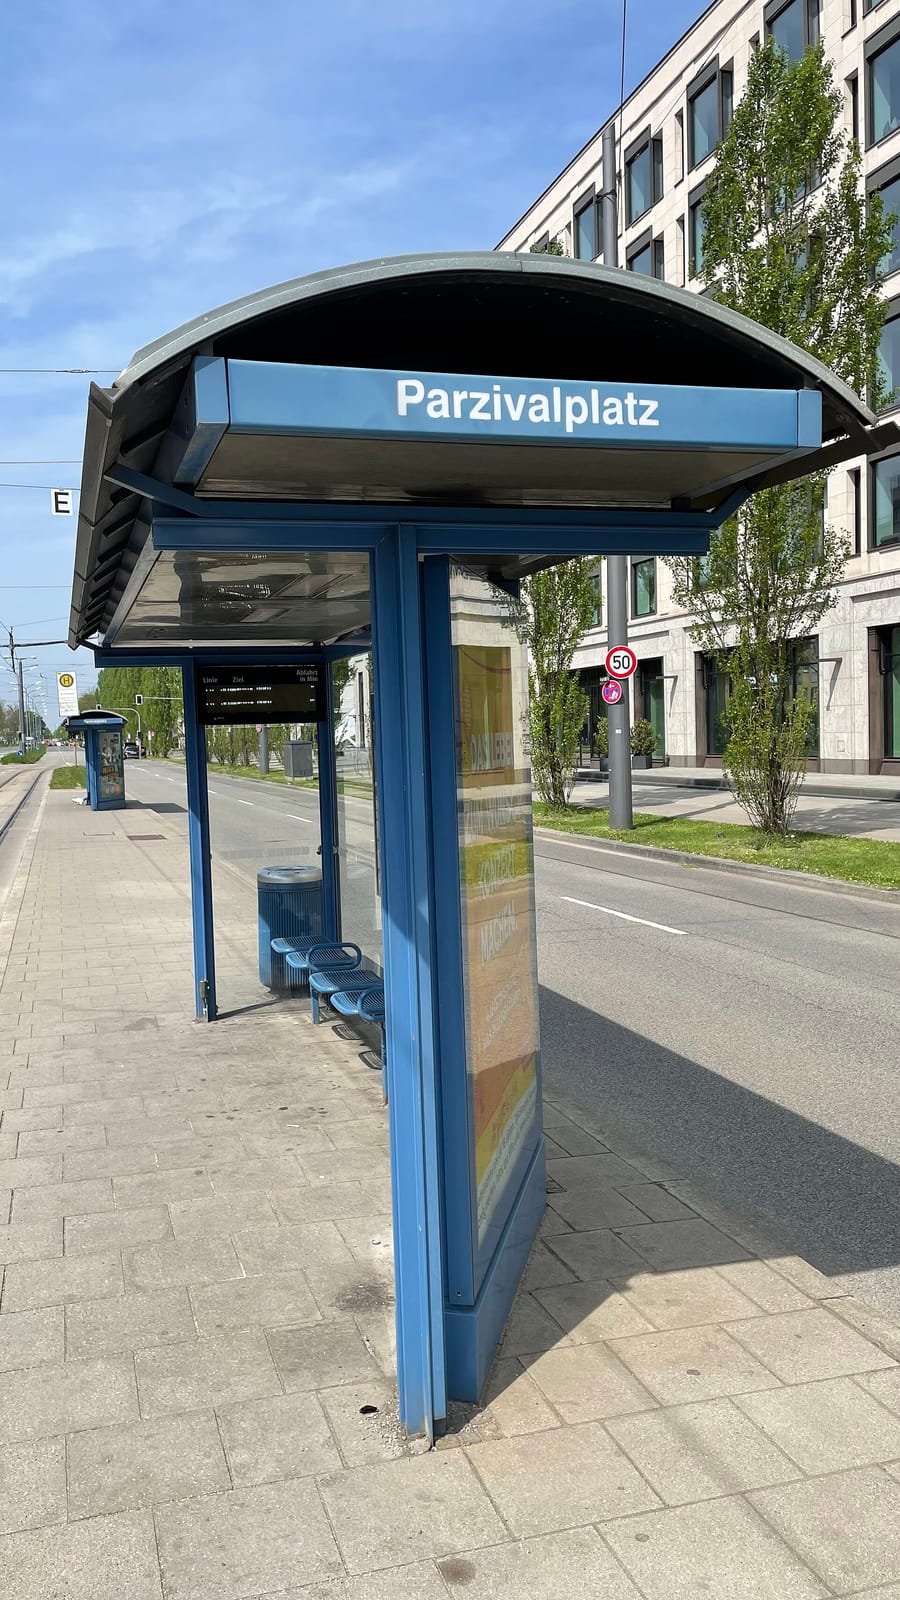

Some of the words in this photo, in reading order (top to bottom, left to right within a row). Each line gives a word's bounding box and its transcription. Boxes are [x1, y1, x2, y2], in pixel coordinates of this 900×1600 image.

[397, 379, 660, 433] Parzivalplatz
[54, 491, 70, 513] E
[613, 655, 630, 669] 50
[63, 676, 70, 685] H
